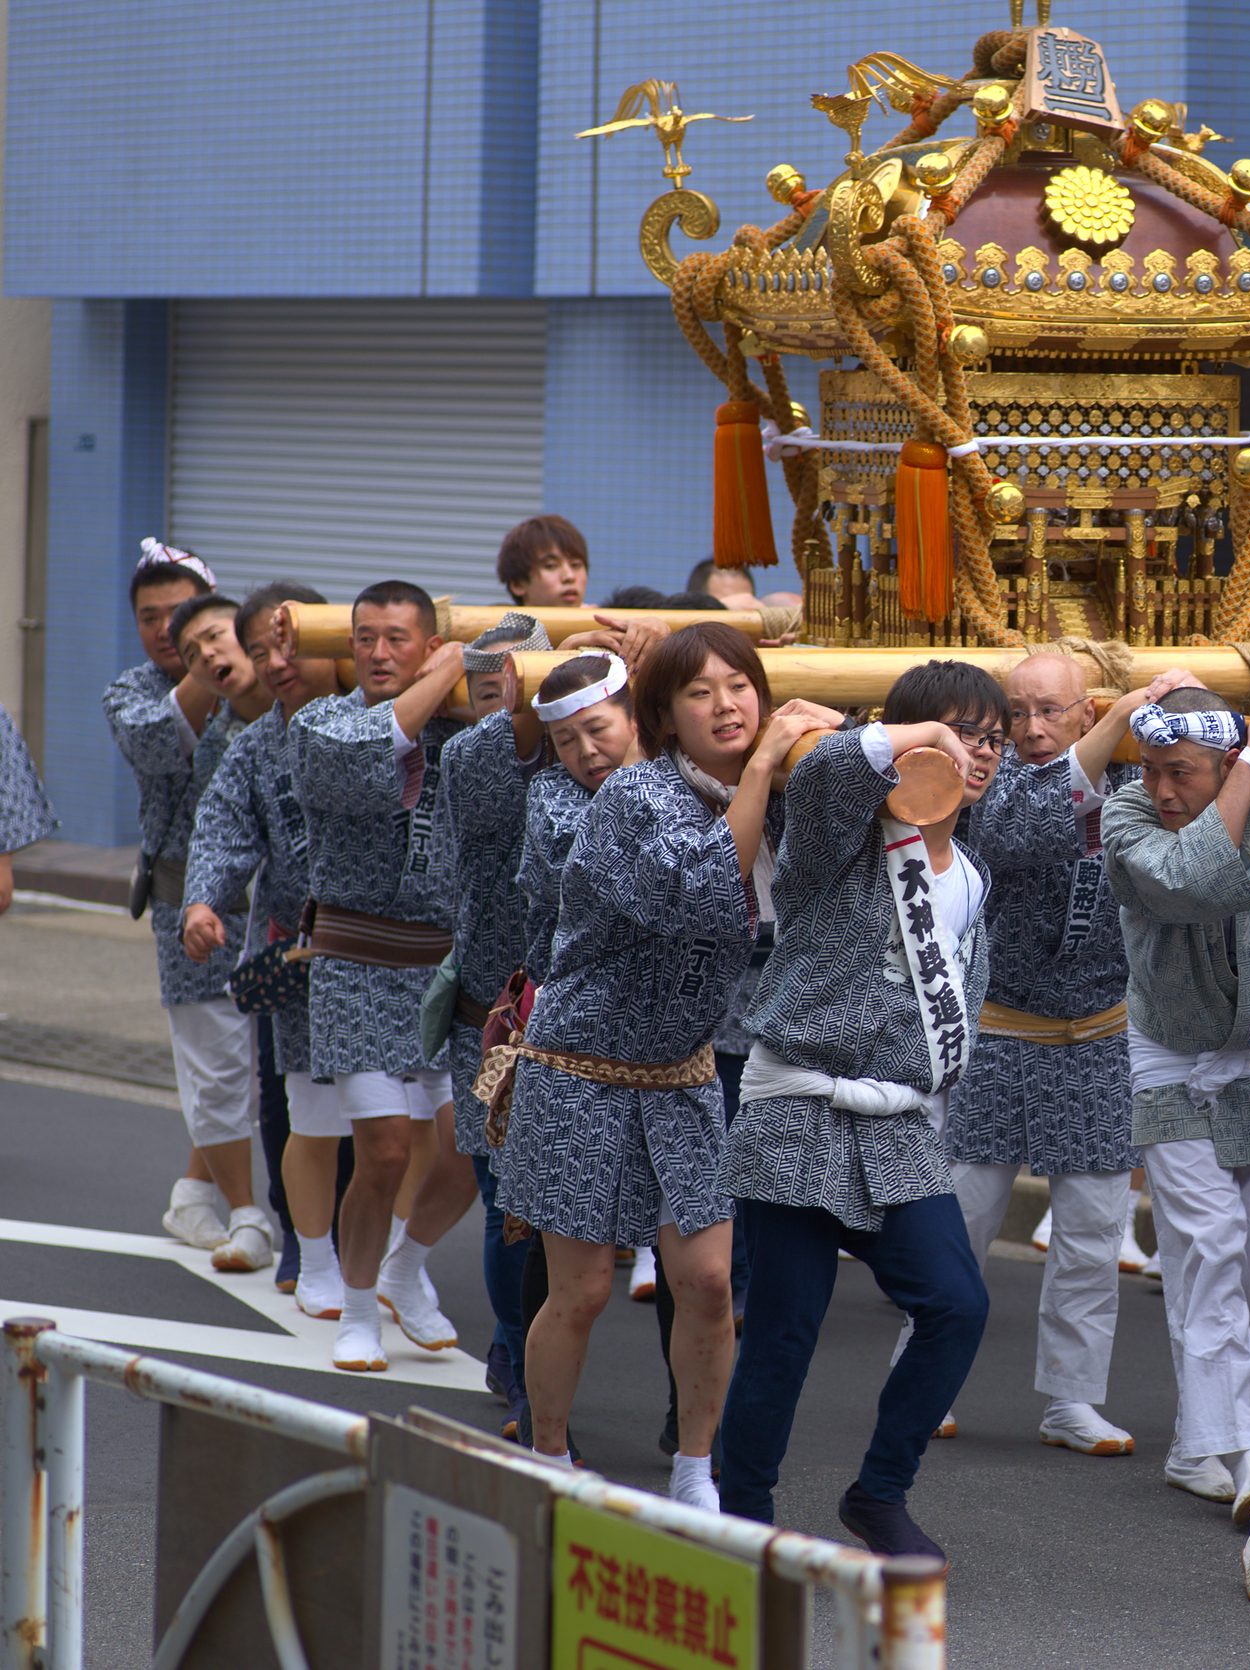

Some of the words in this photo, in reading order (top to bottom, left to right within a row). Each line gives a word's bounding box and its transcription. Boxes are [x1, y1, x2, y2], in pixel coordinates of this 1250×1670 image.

[568, 1541, 740, 1669] 不法投棄禁止
